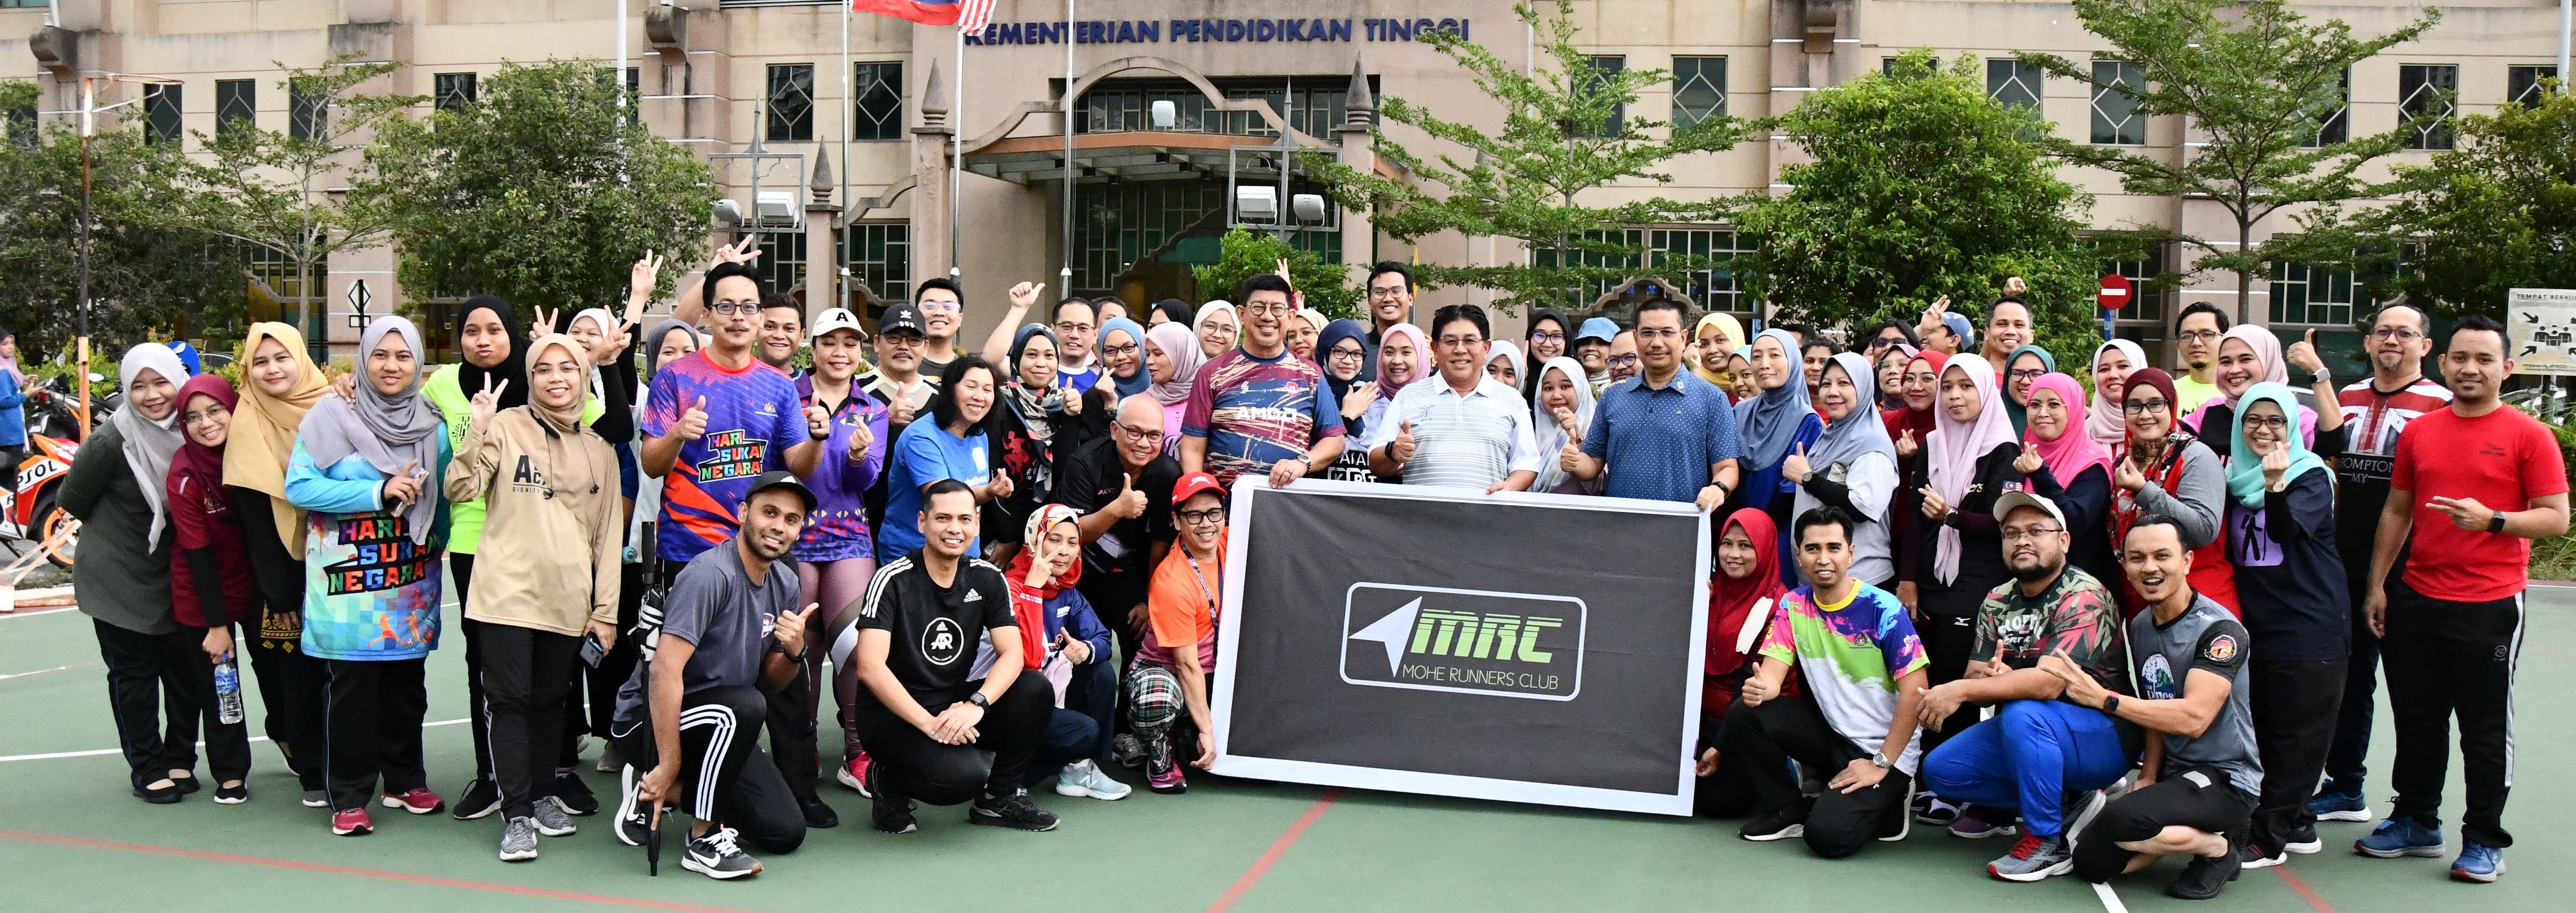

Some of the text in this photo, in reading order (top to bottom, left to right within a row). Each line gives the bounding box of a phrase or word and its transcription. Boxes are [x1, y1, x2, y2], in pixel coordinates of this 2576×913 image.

[1171, 19, 1352, 42] PENDIDIKAN
[1364, 18, 1468, 41] TINGGI
[835, 312, 849, 322] A
[711, 432, 743, 448] HARI
[702, 462, 761, 480] NEGARA
[2352, 473, 2368, 483] MY
[340, 518, 402, 542] HARI
[329, 561, 424, 593] NEGARA
[1410, 609, 1563, 663] MRC
[1402, 664, 1559, 690] MOHE RUNNERS CLUB
